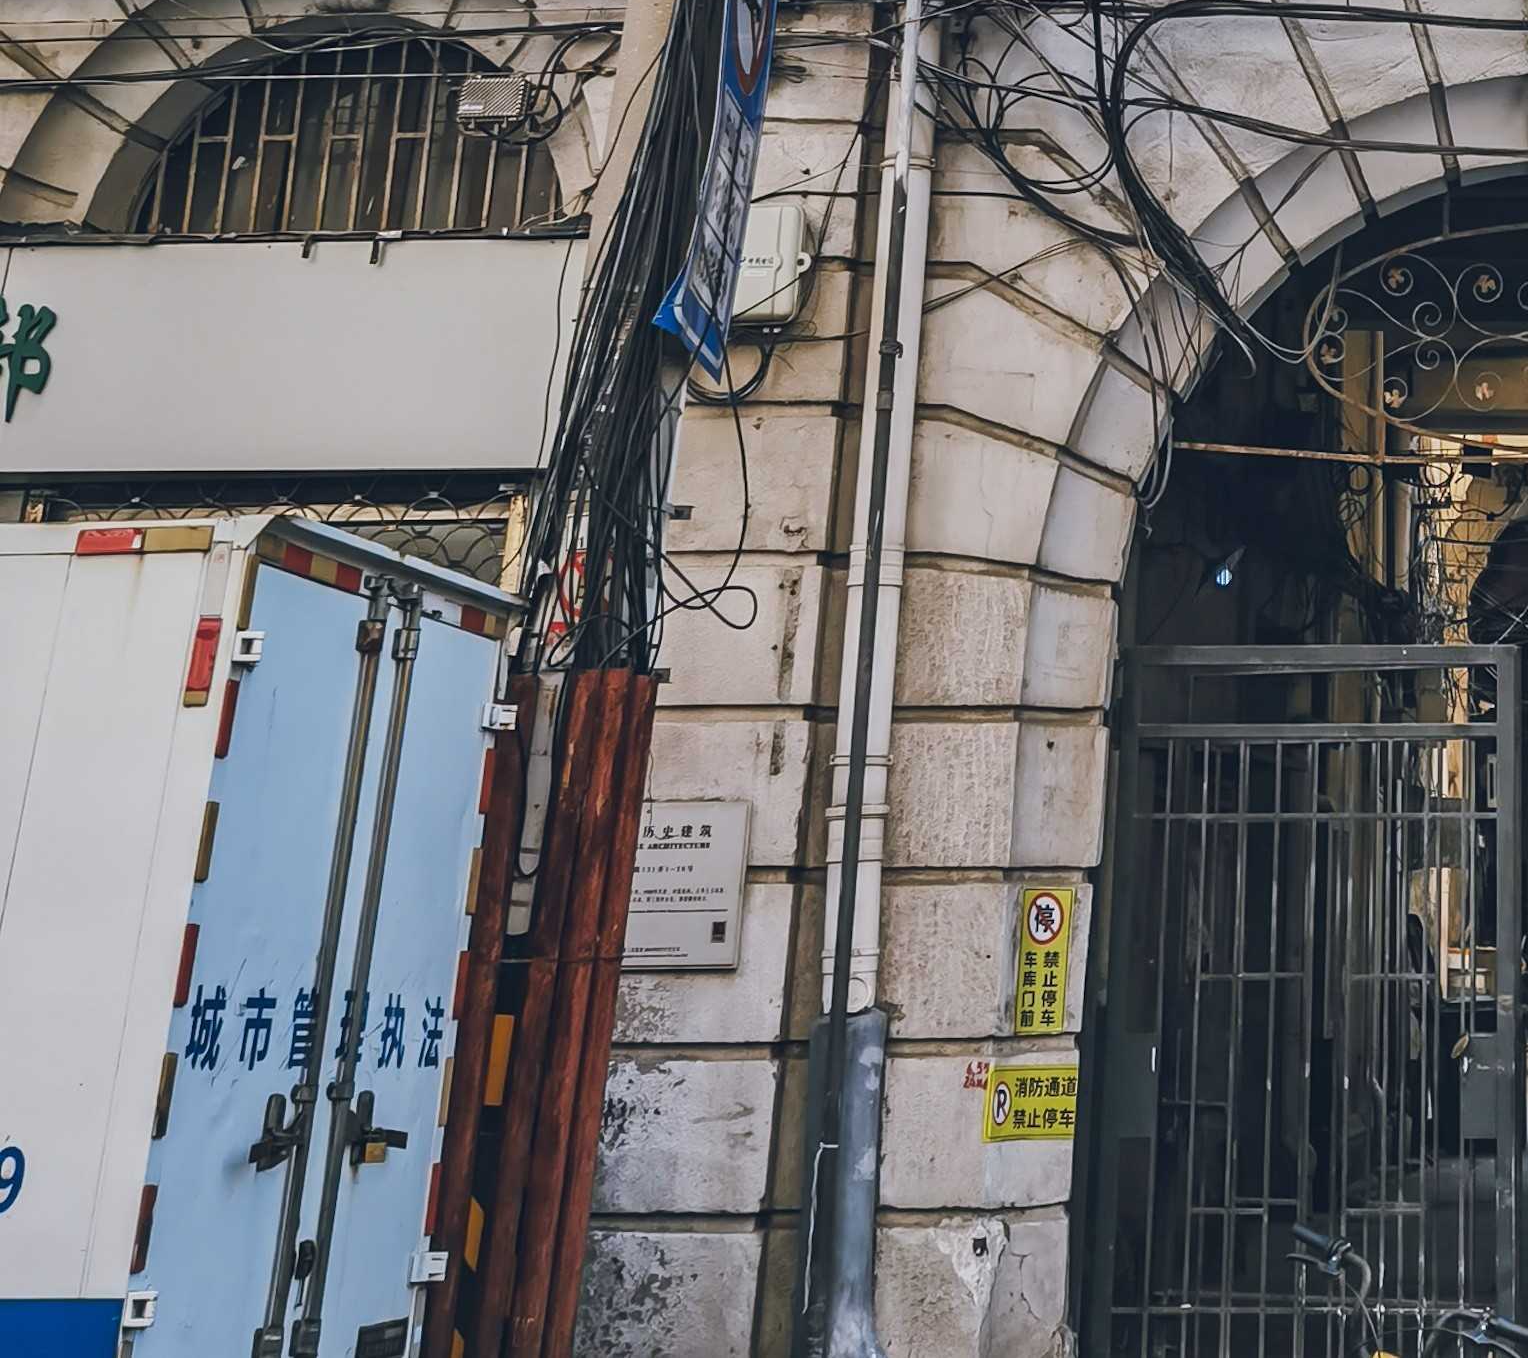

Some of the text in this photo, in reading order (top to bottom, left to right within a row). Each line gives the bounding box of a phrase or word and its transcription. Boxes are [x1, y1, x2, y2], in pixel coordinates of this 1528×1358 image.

[1020, 950, 1038, 1027] 车库门前
[1040, 950, 1060, 1026] 禁止停车
[185, 984, 445, 1071] 城市管理执法
[1013, 1108, 1075, 1129] 禁止停车
[1014, 1076, 1078, 1098] 消防通道
